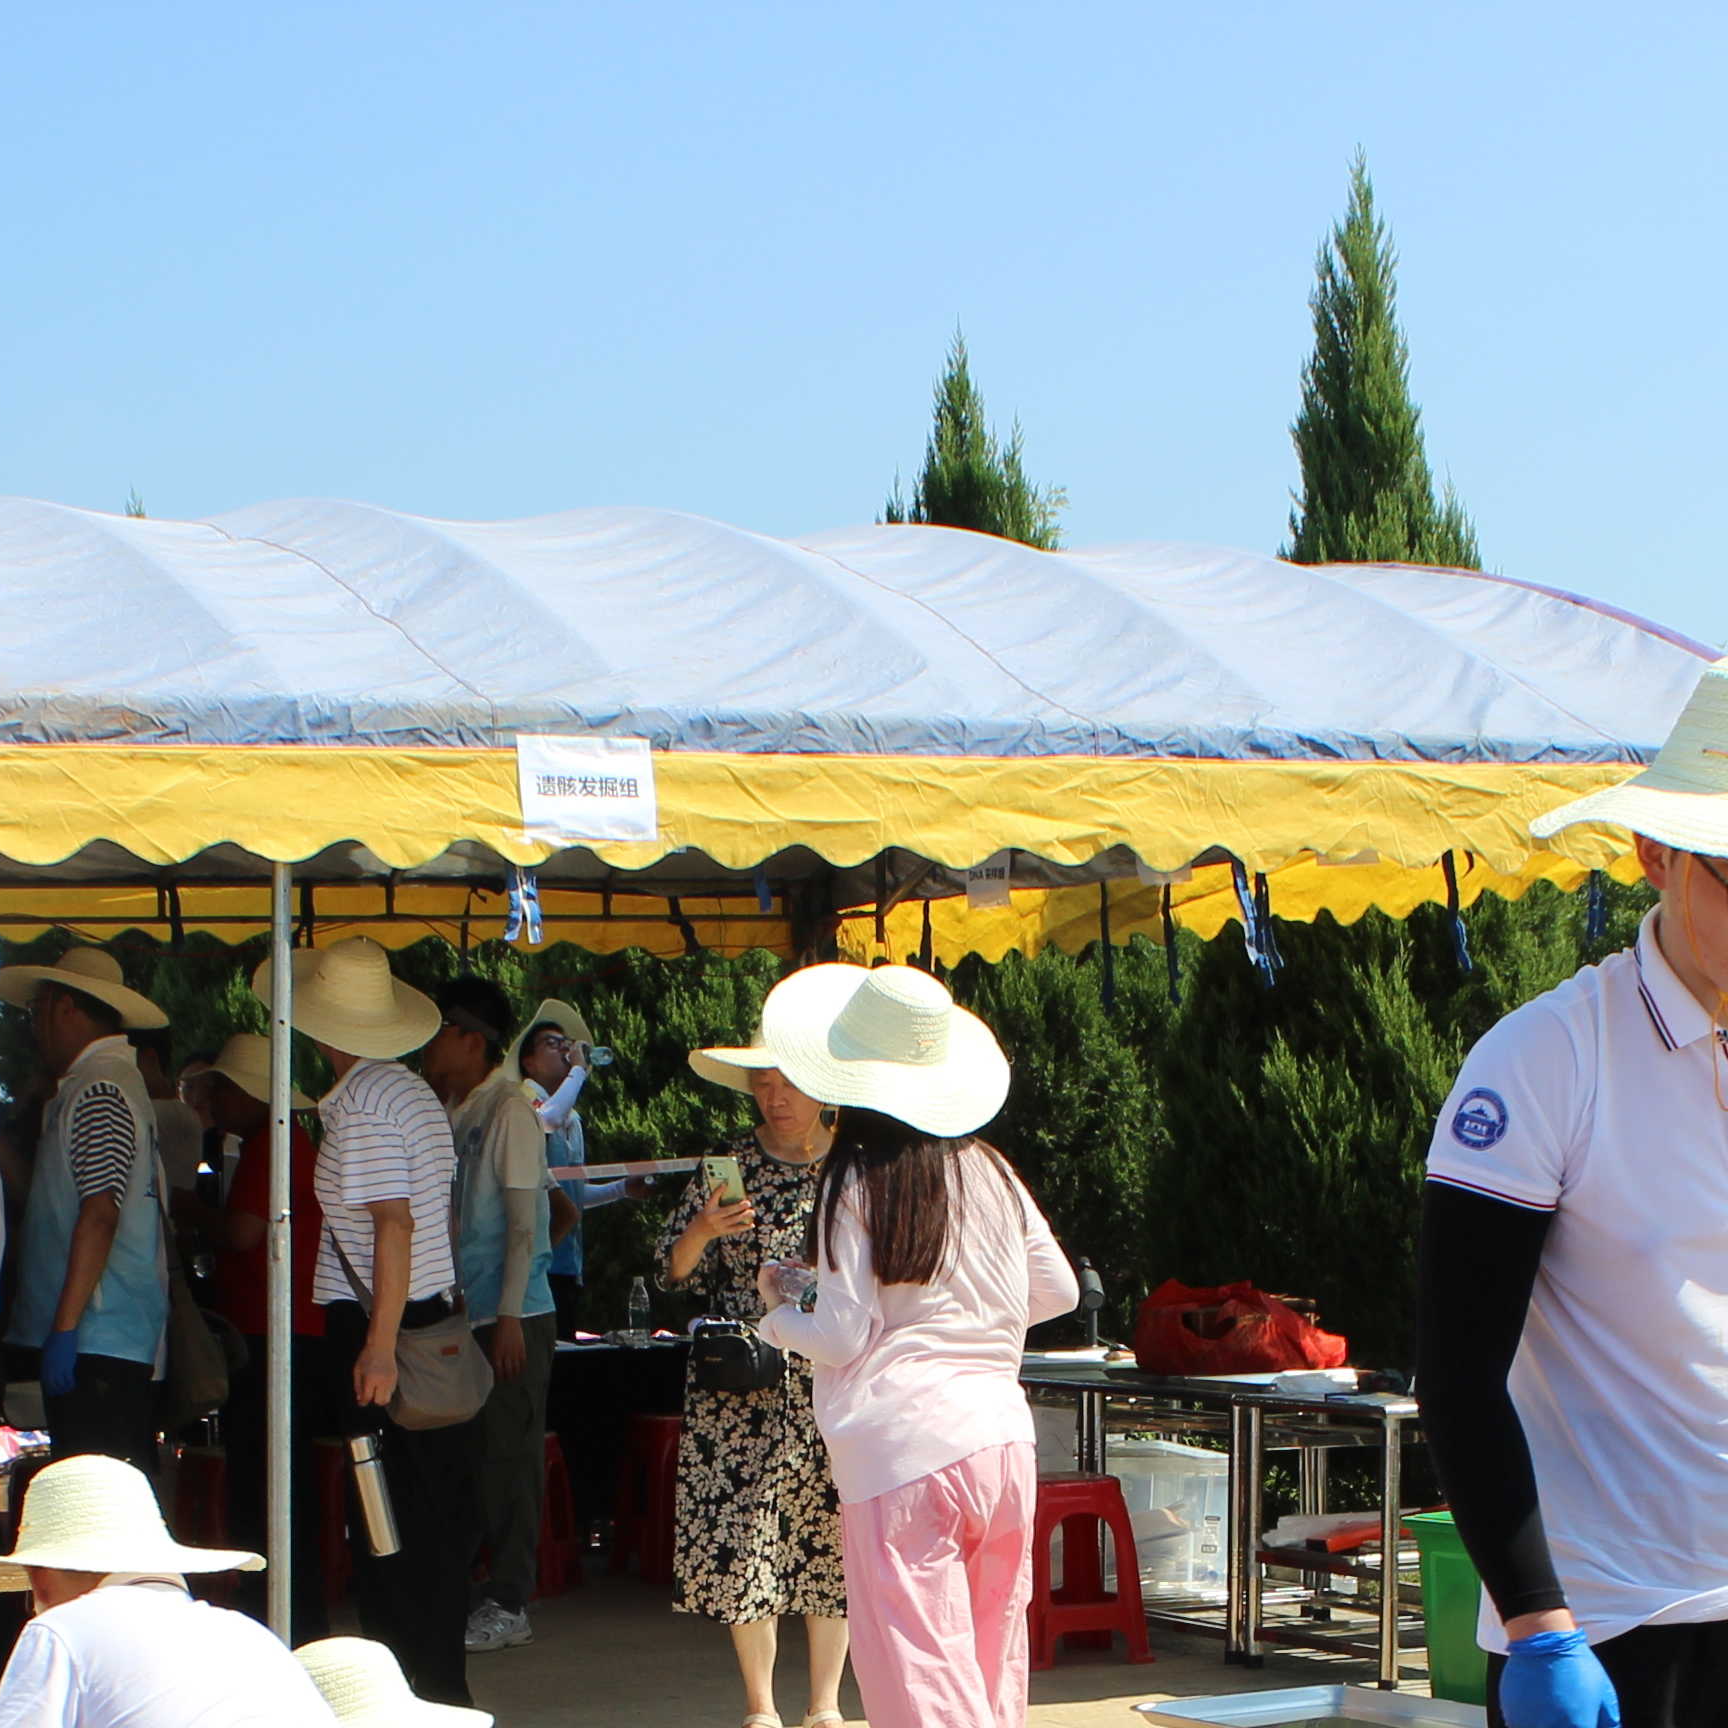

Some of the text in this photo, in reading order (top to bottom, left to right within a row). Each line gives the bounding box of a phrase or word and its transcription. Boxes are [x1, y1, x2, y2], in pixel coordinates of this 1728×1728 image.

[537, 775, 639, 798] 遗骸发掘组
